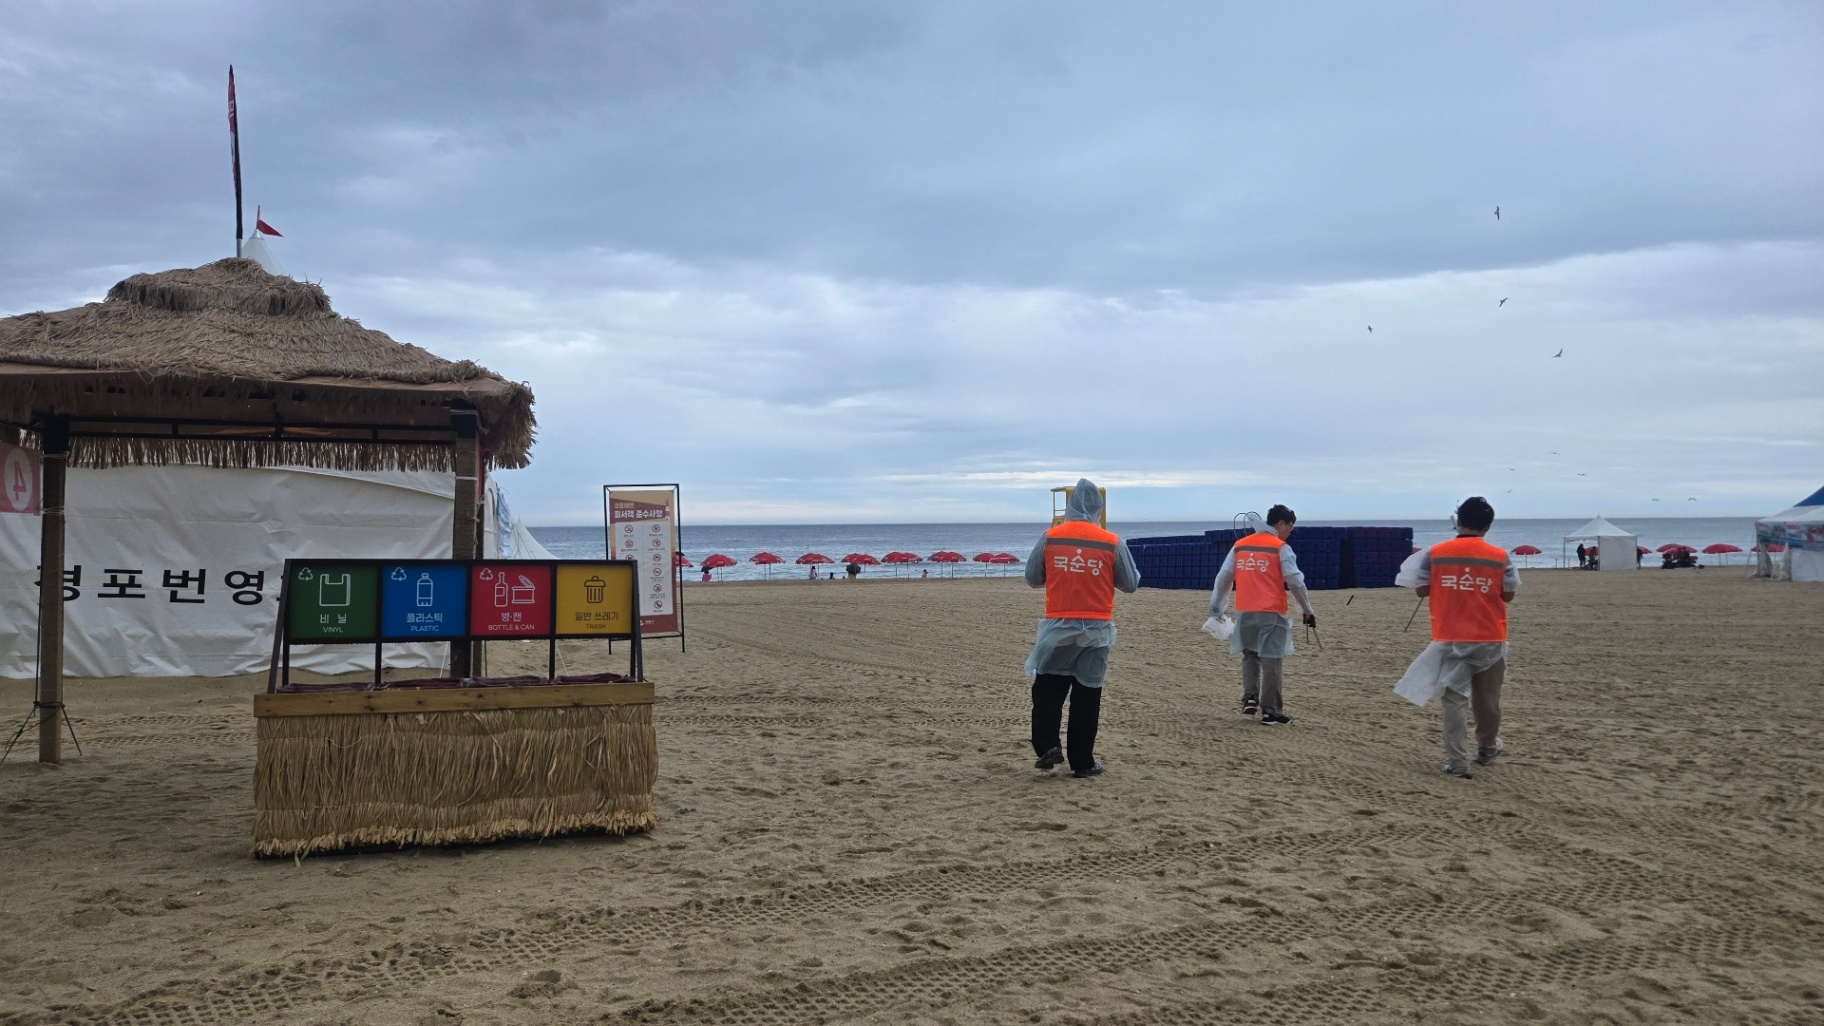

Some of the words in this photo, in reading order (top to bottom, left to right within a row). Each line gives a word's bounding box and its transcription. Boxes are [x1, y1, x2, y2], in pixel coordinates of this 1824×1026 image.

[1054, 548, 1104, 576] 국순당
[1236, 552, 1270, 573] 국순당
[34, 564, 284, 606] 경포번영
[1441, 567, 1494, 593] 국순당
[406, 612, 443, 623] 플라스틱
[575, 612, 591, 621] 일반
[594, 611, 619, 621] 쓰레기
